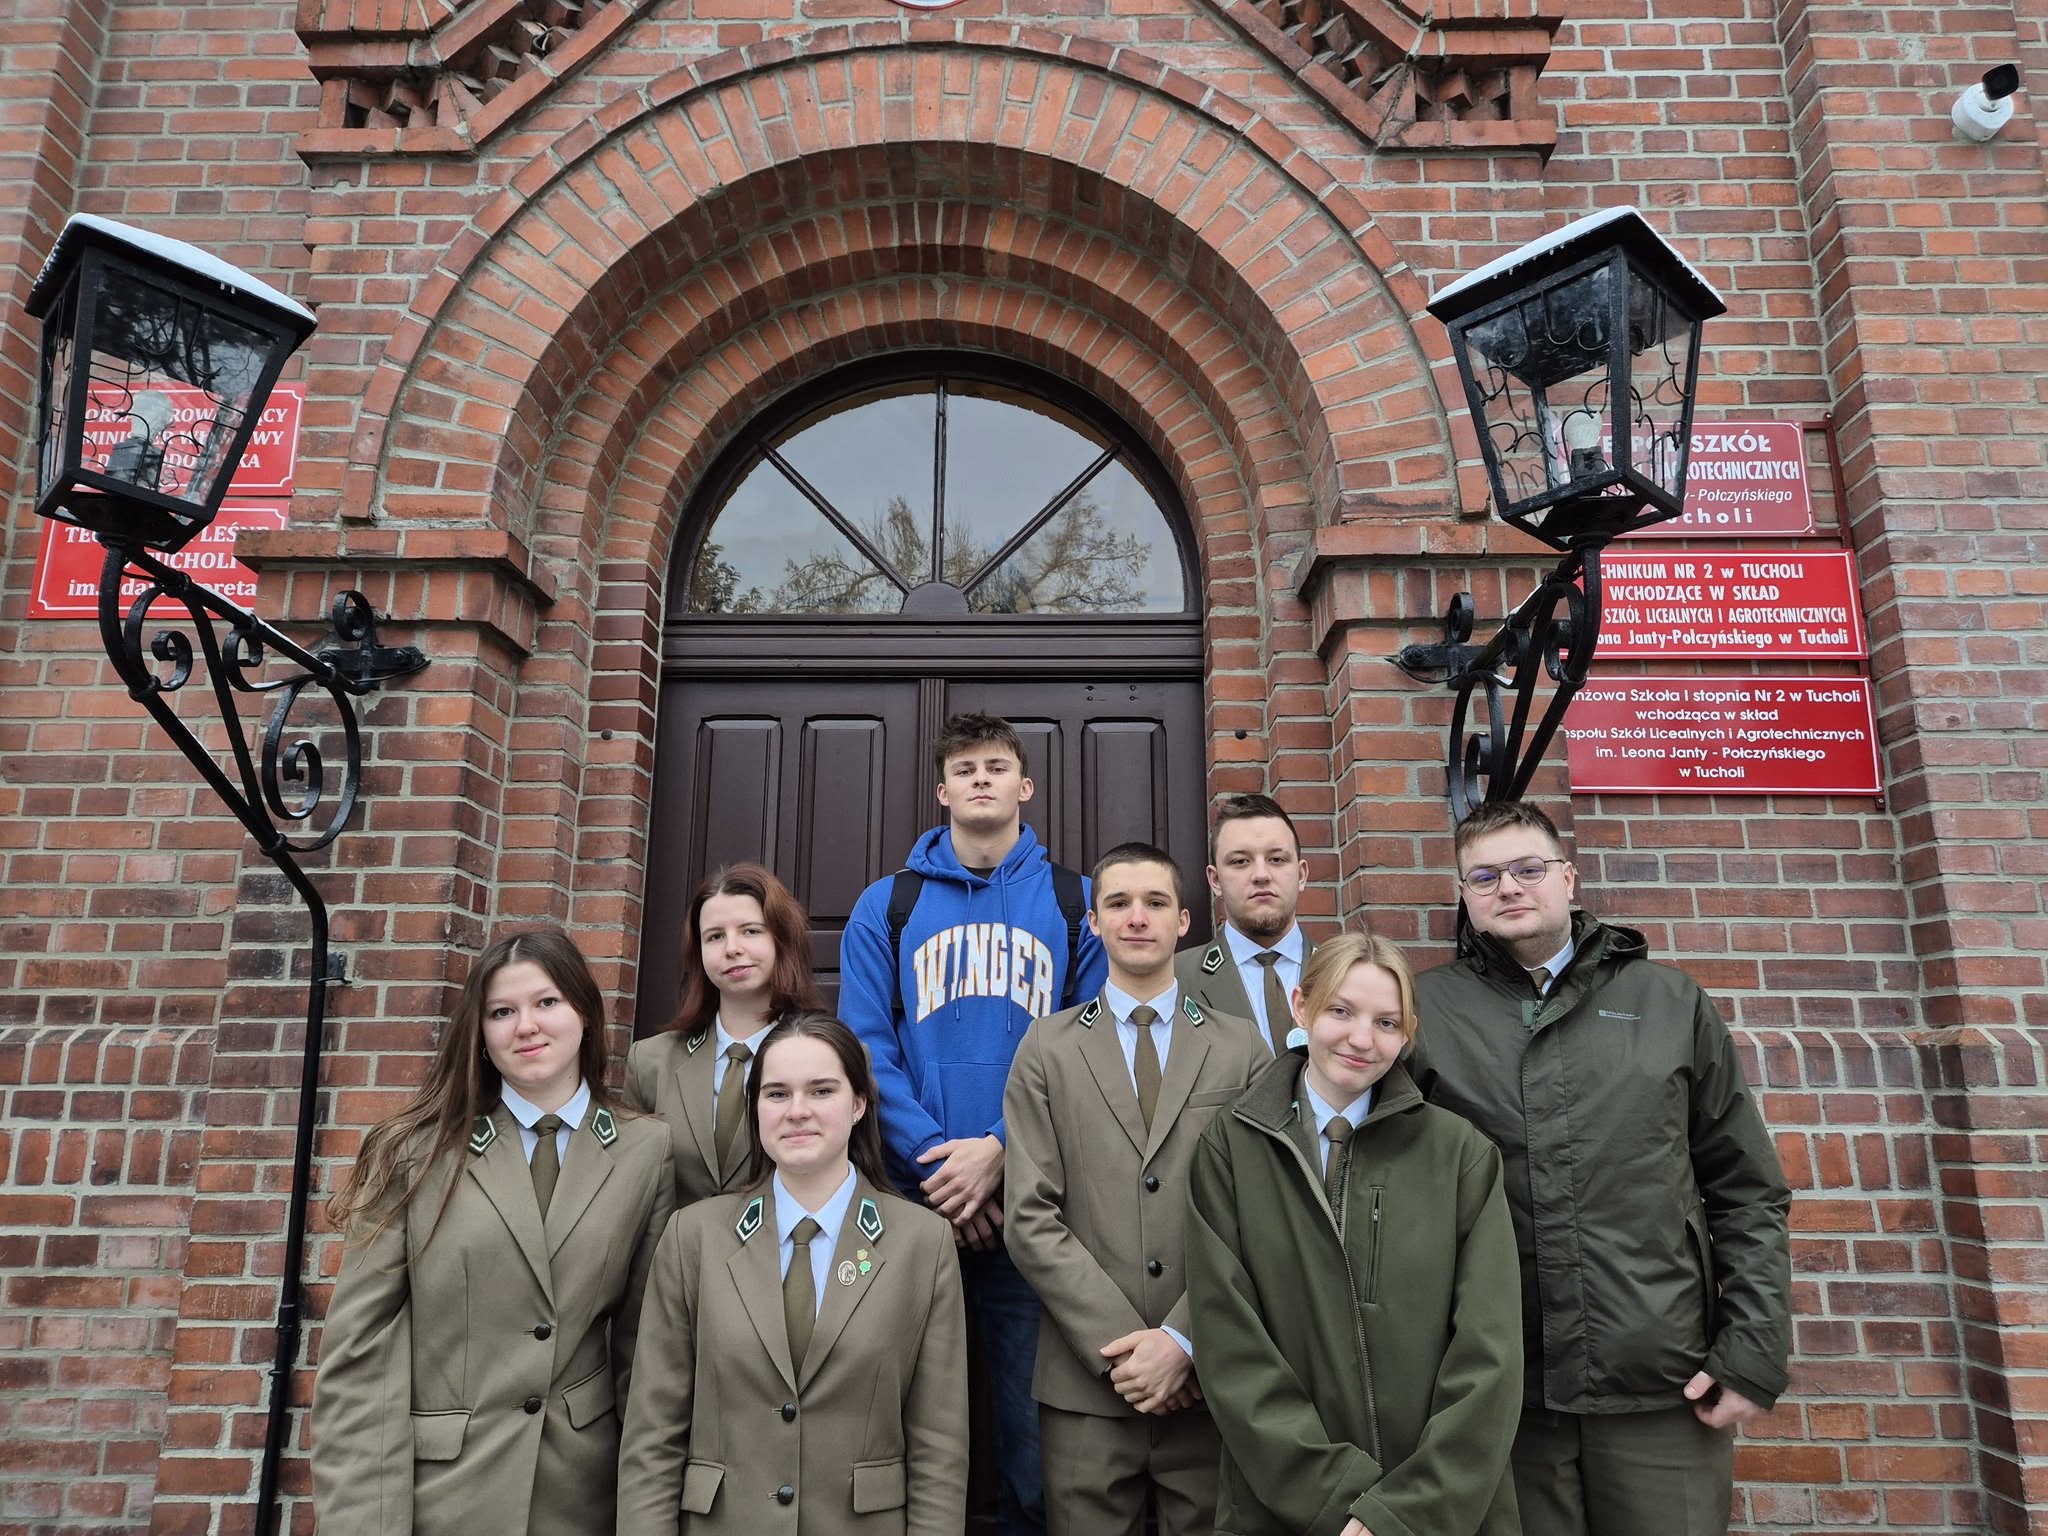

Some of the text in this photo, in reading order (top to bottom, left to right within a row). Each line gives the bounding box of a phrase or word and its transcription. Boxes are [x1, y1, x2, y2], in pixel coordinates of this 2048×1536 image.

[1690, 430, 1772, 453] SZKÓŁ
[1698, 488, 1793, 503] Połczyńskiego
[1674, 563, 1696, 579] NR
[1703, 563, 1713, 579] 2
[1720, 567, 1734, 579] w
[1741, 563, 1803, 579] TUCHOLI
[1609, 585, 1780, 604] WCHODZĄCE W SKŁAD
[1604, 605, 1847, 624] SZKÓŁ LICEALNYCH I AGROTECHNICZNYCH
[1596, 633, 1622, 645] ona
[1778, 633, 1792, 644] w
[1798, 628, 1849, 645] Tucholi
[1630, 688, 1680, 702] Szkoła
[1693, 689, 1750, 704] stopnia
[1755, 689, 1772, 702] Nr
[1776, 689, 1786, 702] 2
[1789, 692, 1803, 702] w
[1806, 689, 1861, 703] Tucholi
[1635, 709, 1779, 723] wchodząca w skład
[1565, 727, 1865, 742] espołu Szkół Licealnych i Agrotechnicznych
[1596, 746, 1617, 758] im.
[1621, 746, 1666, 758] Leona
[1669, 746, 1708, 761] Janty
[1722, 747, 1826, 762] Połczyńskiego
[1679, 766, 1745, 778] w Tucholi
[913, 922, 1053, 1024] WINGER
